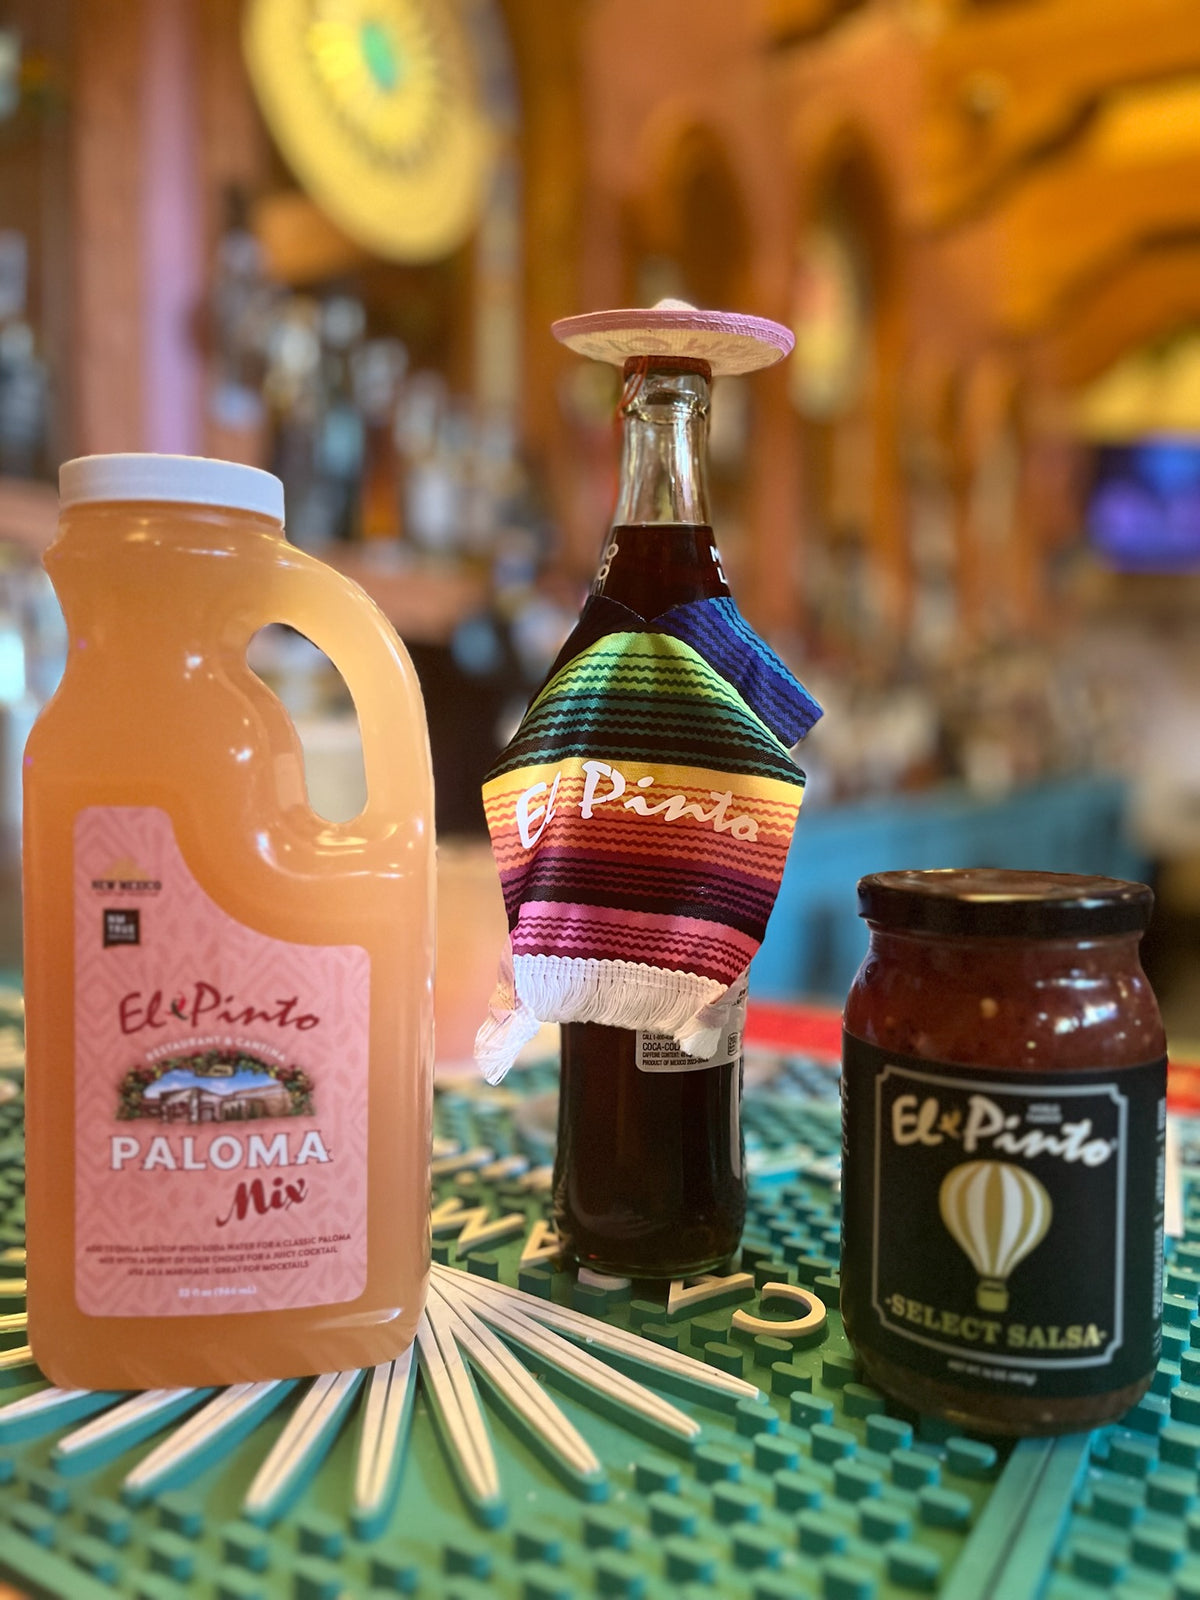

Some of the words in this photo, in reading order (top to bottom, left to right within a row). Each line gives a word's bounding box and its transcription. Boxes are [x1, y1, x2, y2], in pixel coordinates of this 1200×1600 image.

[515, 771, 562, 850] El
[578, 760, 759, 842] Pinto
[119, 990, 167, 1035] El
[190, 981, 320, 1031] Pinto
[145, 1035, 220, 1060] RESTAURANT
[235, 1038, 285, 1061] CANTINA
[109, 1129, 333, 1172] PALOMA
[891, 1094, 943, 1146] El
[963, 1094, 1113, 1167] Pinto
[215, 1177, 309, 1228] Mix
[211, 1254, 245, 1264] CHOICE
[246, 1252, 264, 1262] FOR
[273, 1250, 296, 1260] JUICY
[298, 1246, 338, 1256] COCKTAIL
[282, 1237, 317, 1247] CLASSIC
[318, 1234, 351, 1243] PALOMA
[261, 1260, 310, 1272] MOCKTAILS
[890, 1293, 1002, 1344] SELECT
[1007, 1322, 1102, 1349] SALSA
